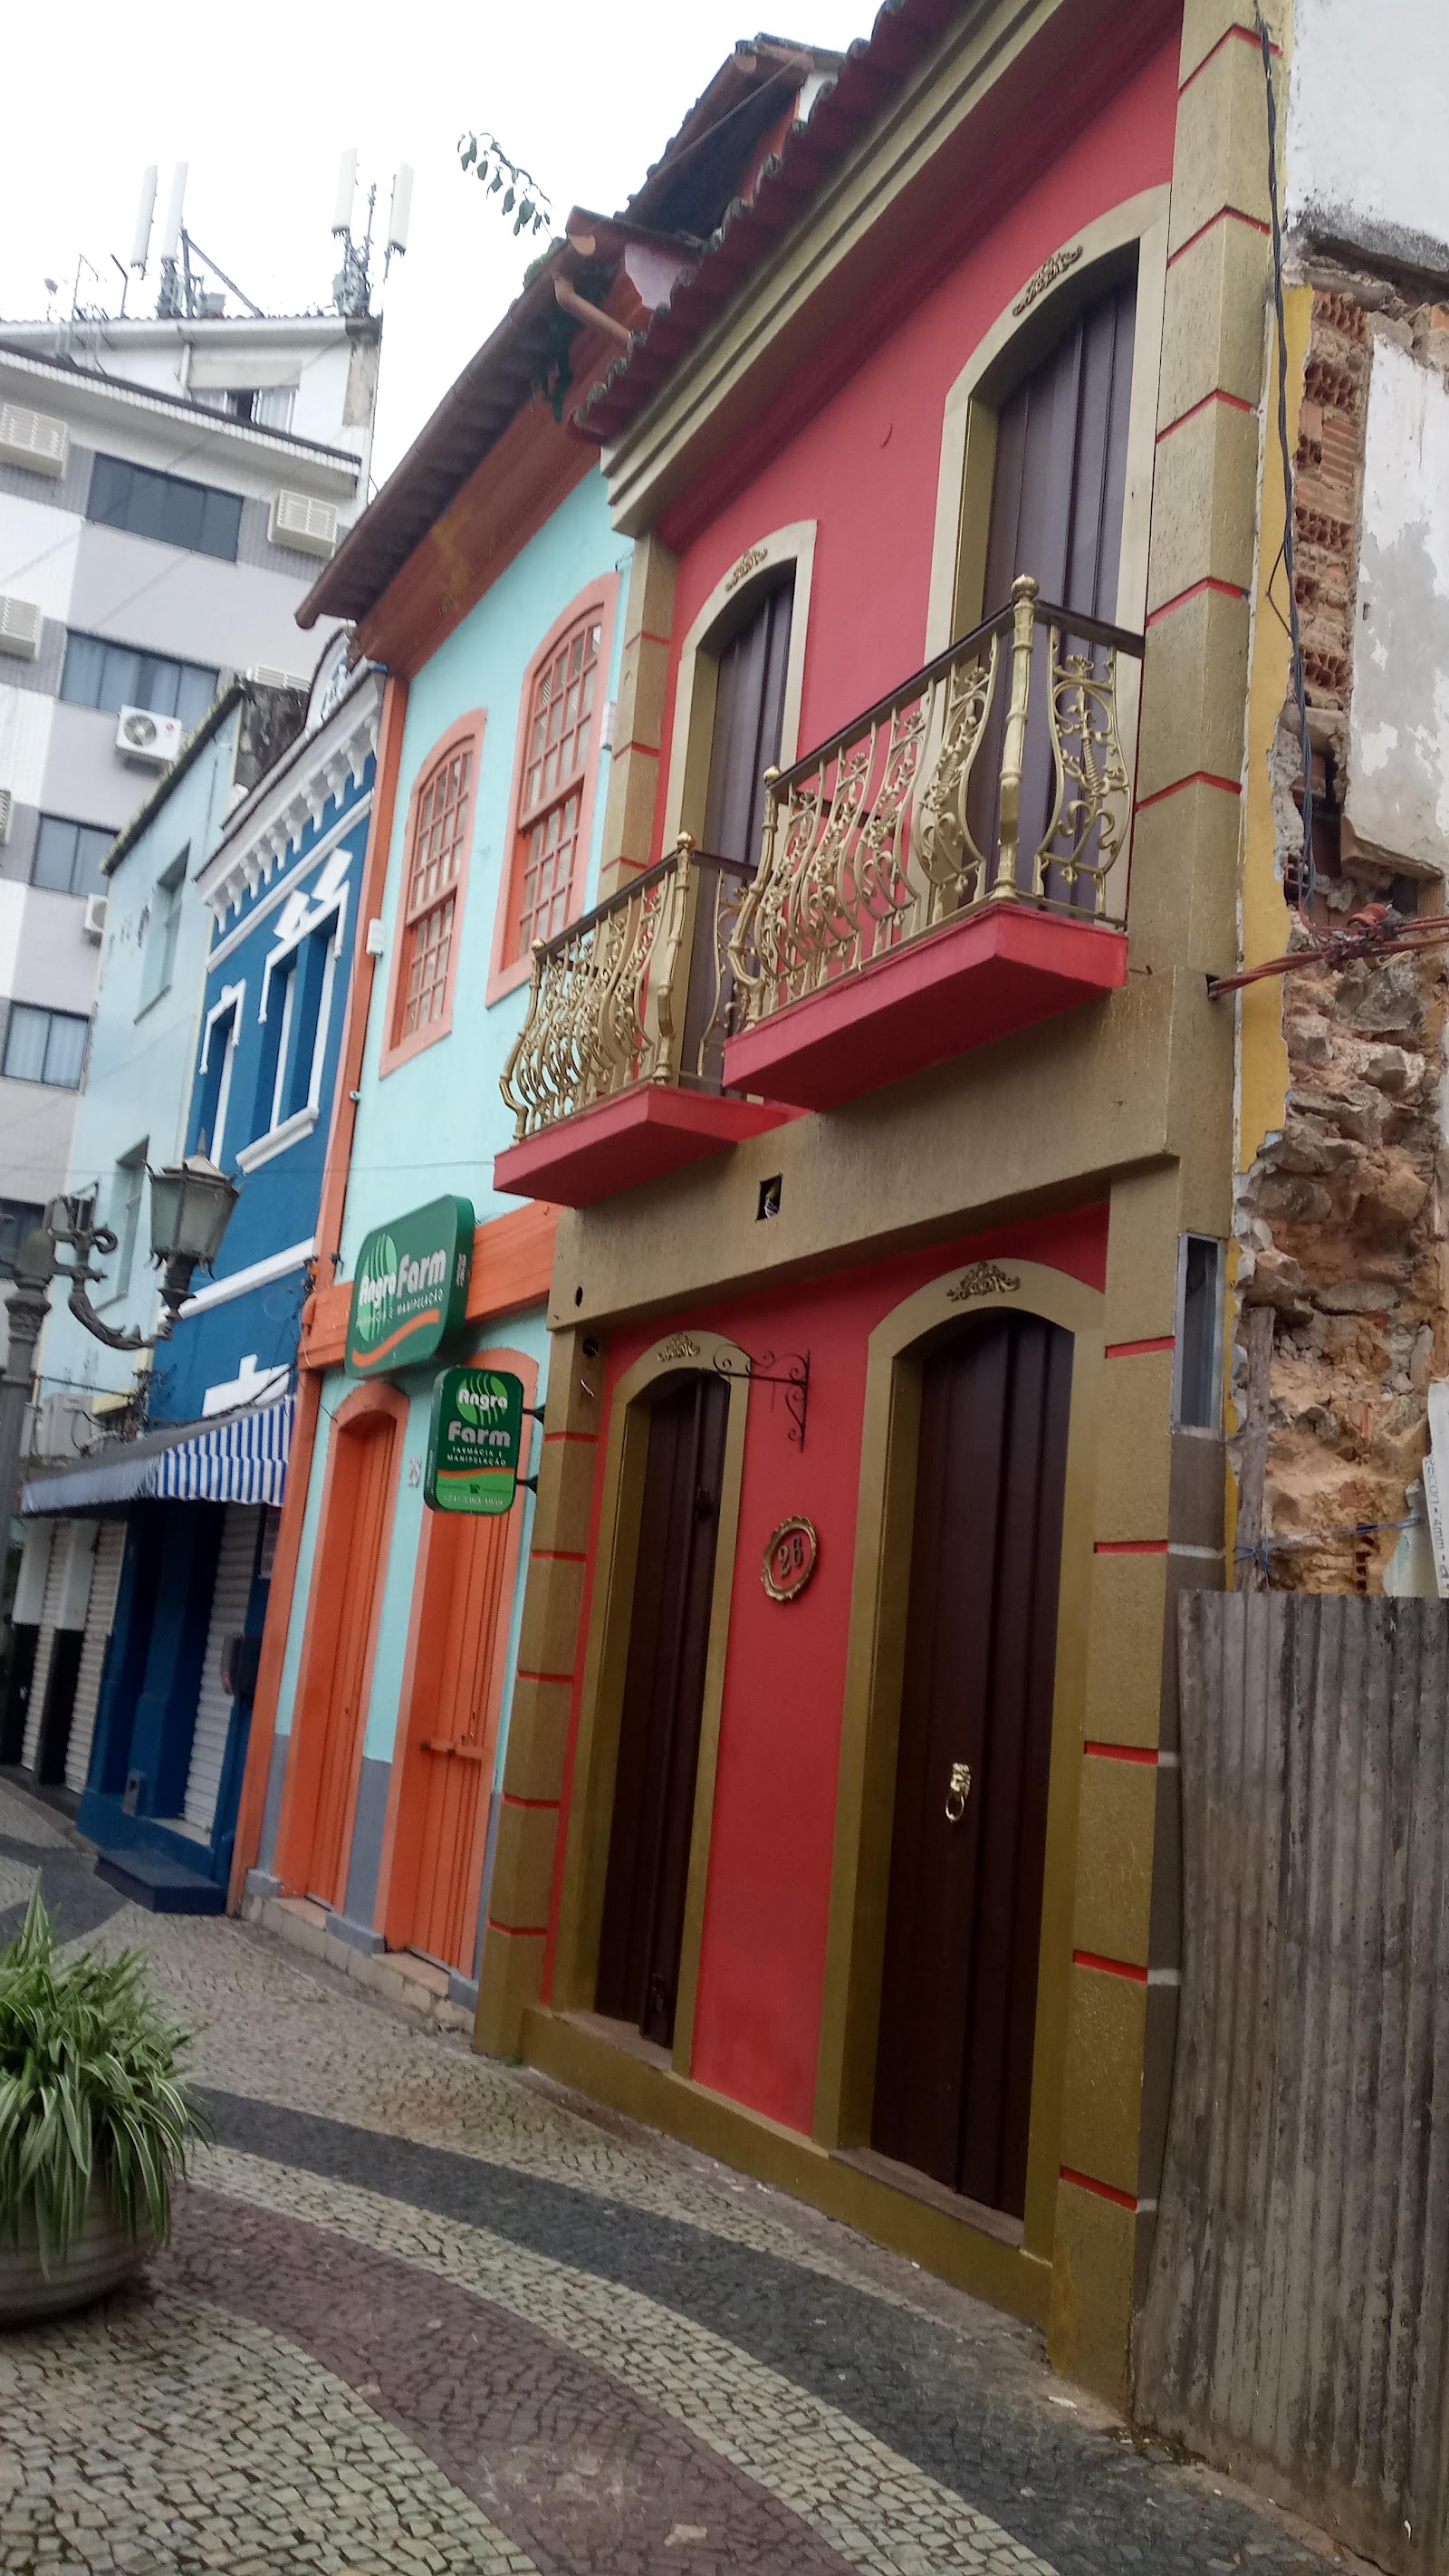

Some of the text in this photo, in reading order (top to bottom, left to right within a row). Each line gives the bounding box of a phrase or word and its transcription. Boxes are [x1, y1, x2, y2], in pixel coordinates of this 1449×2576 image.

[458, 1388, 508, 1411] Angra
[447, 1420, 511, 1448] Farm
[778, 1535, 803, 1578] 98
